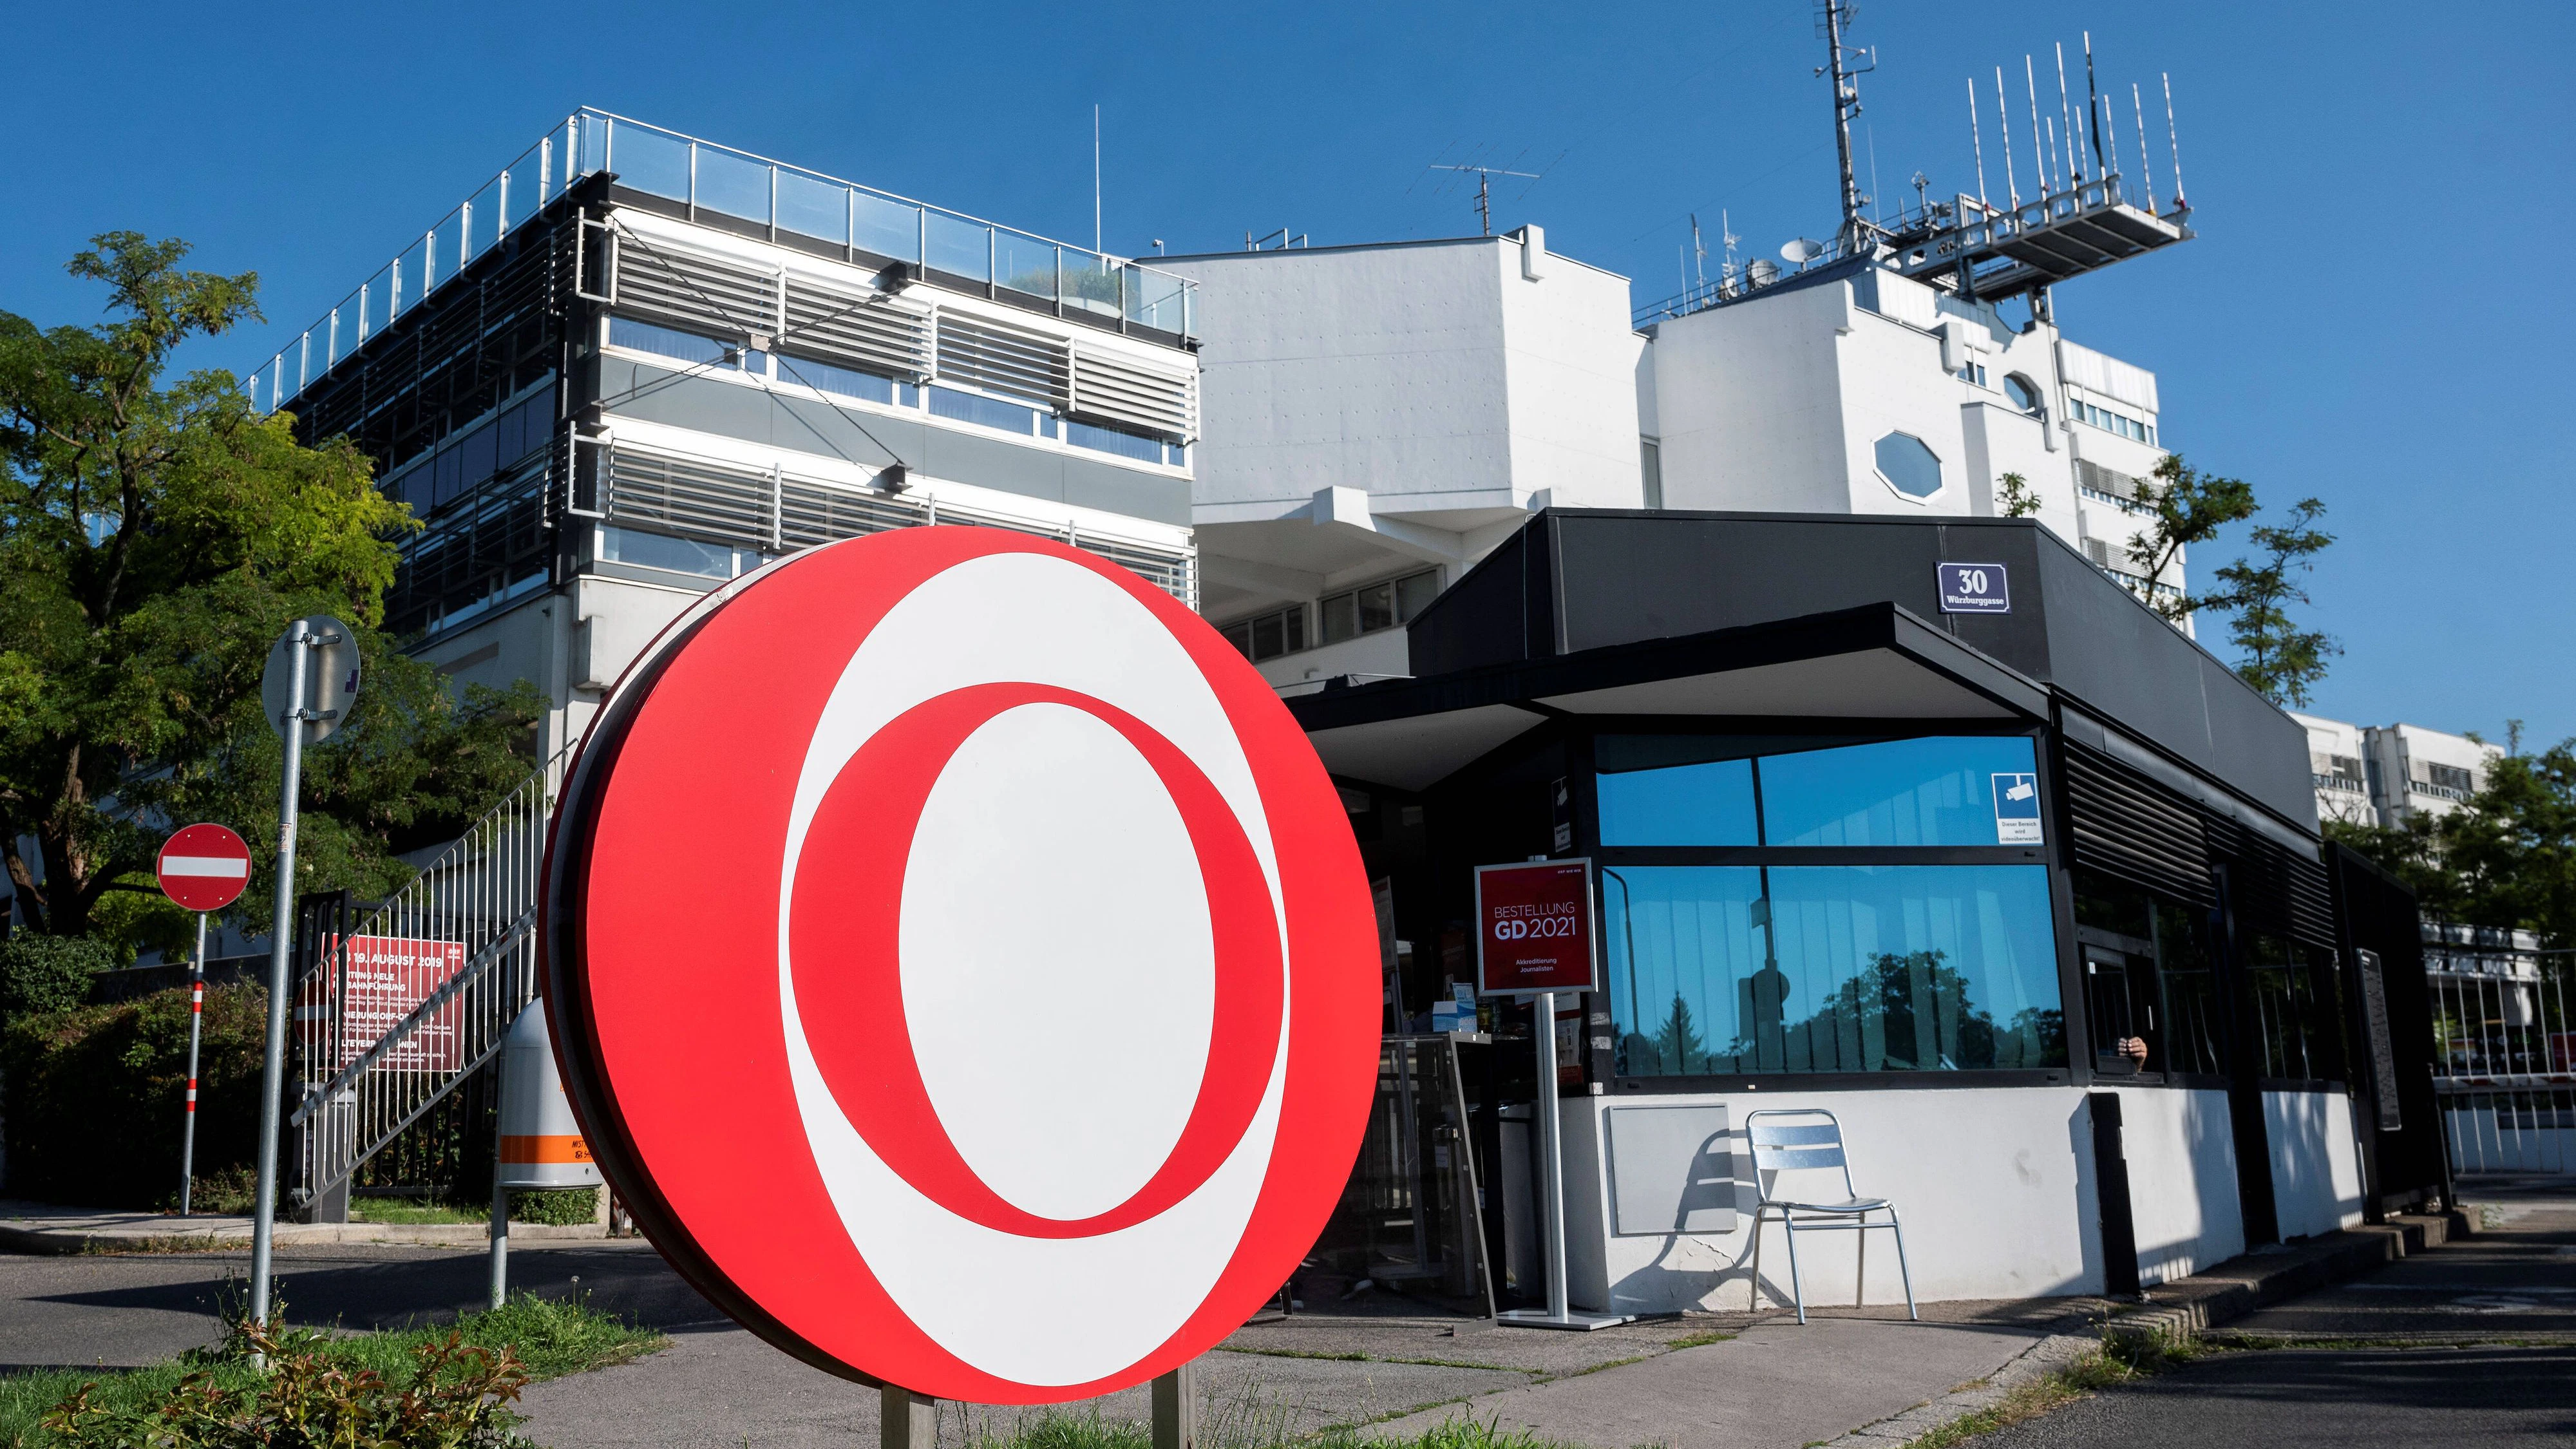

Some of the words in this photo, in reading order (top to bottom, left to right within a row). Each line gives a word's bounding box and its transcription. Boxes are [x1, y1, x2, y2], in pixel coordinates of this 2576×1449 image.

[1958, 569, 1987, 594] 30
[1946, 595, 2004, 607] Würzburggasse
[1494, 902, 1575, 918] BESTELLUNG
[370, 953, 416, 966] AUGUST
[418, 956, 442, 968] 2019
[572, 1140, 585, 1148] MIST
